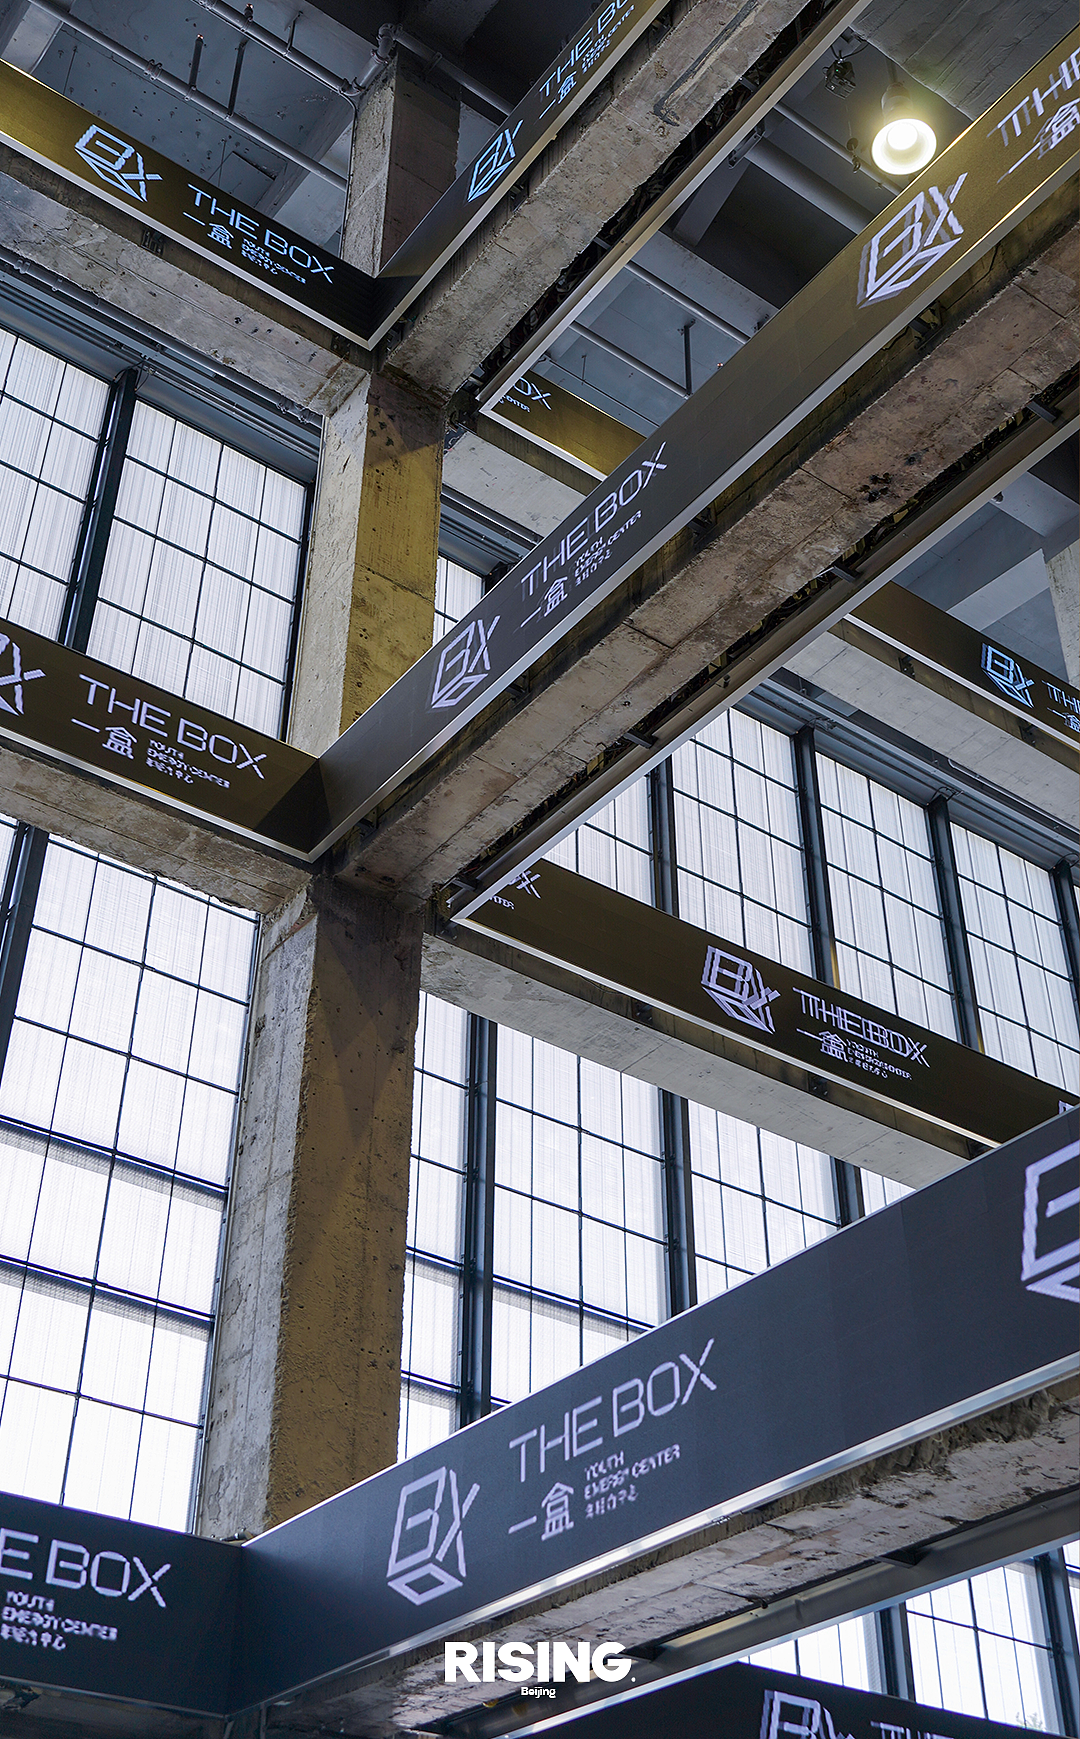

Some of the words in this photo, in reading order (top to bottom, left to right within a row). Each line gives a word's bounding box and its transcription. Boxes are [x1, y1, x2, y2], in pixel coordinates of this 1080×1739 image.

[539, 27, 593, 98] THE
[187, 183, 260, 241] THE
[264, 228, 335, 284] BOX
[519, 516, 589, 597] THE
[593, 441, 668, 534] BOX
[519, 575, 568, 628] 一盒
[70, 718, 138, 760] 一盒
[79, 673, 172, 738] THE
[176, 717, 268, 780] BOX
[508, 1396, 603, 1482] THE
[612, 1337, 718, 1437] BOX
[508, 1482, 574, 1541] 一盒
[45, 1539, 171, 1608] BOX
